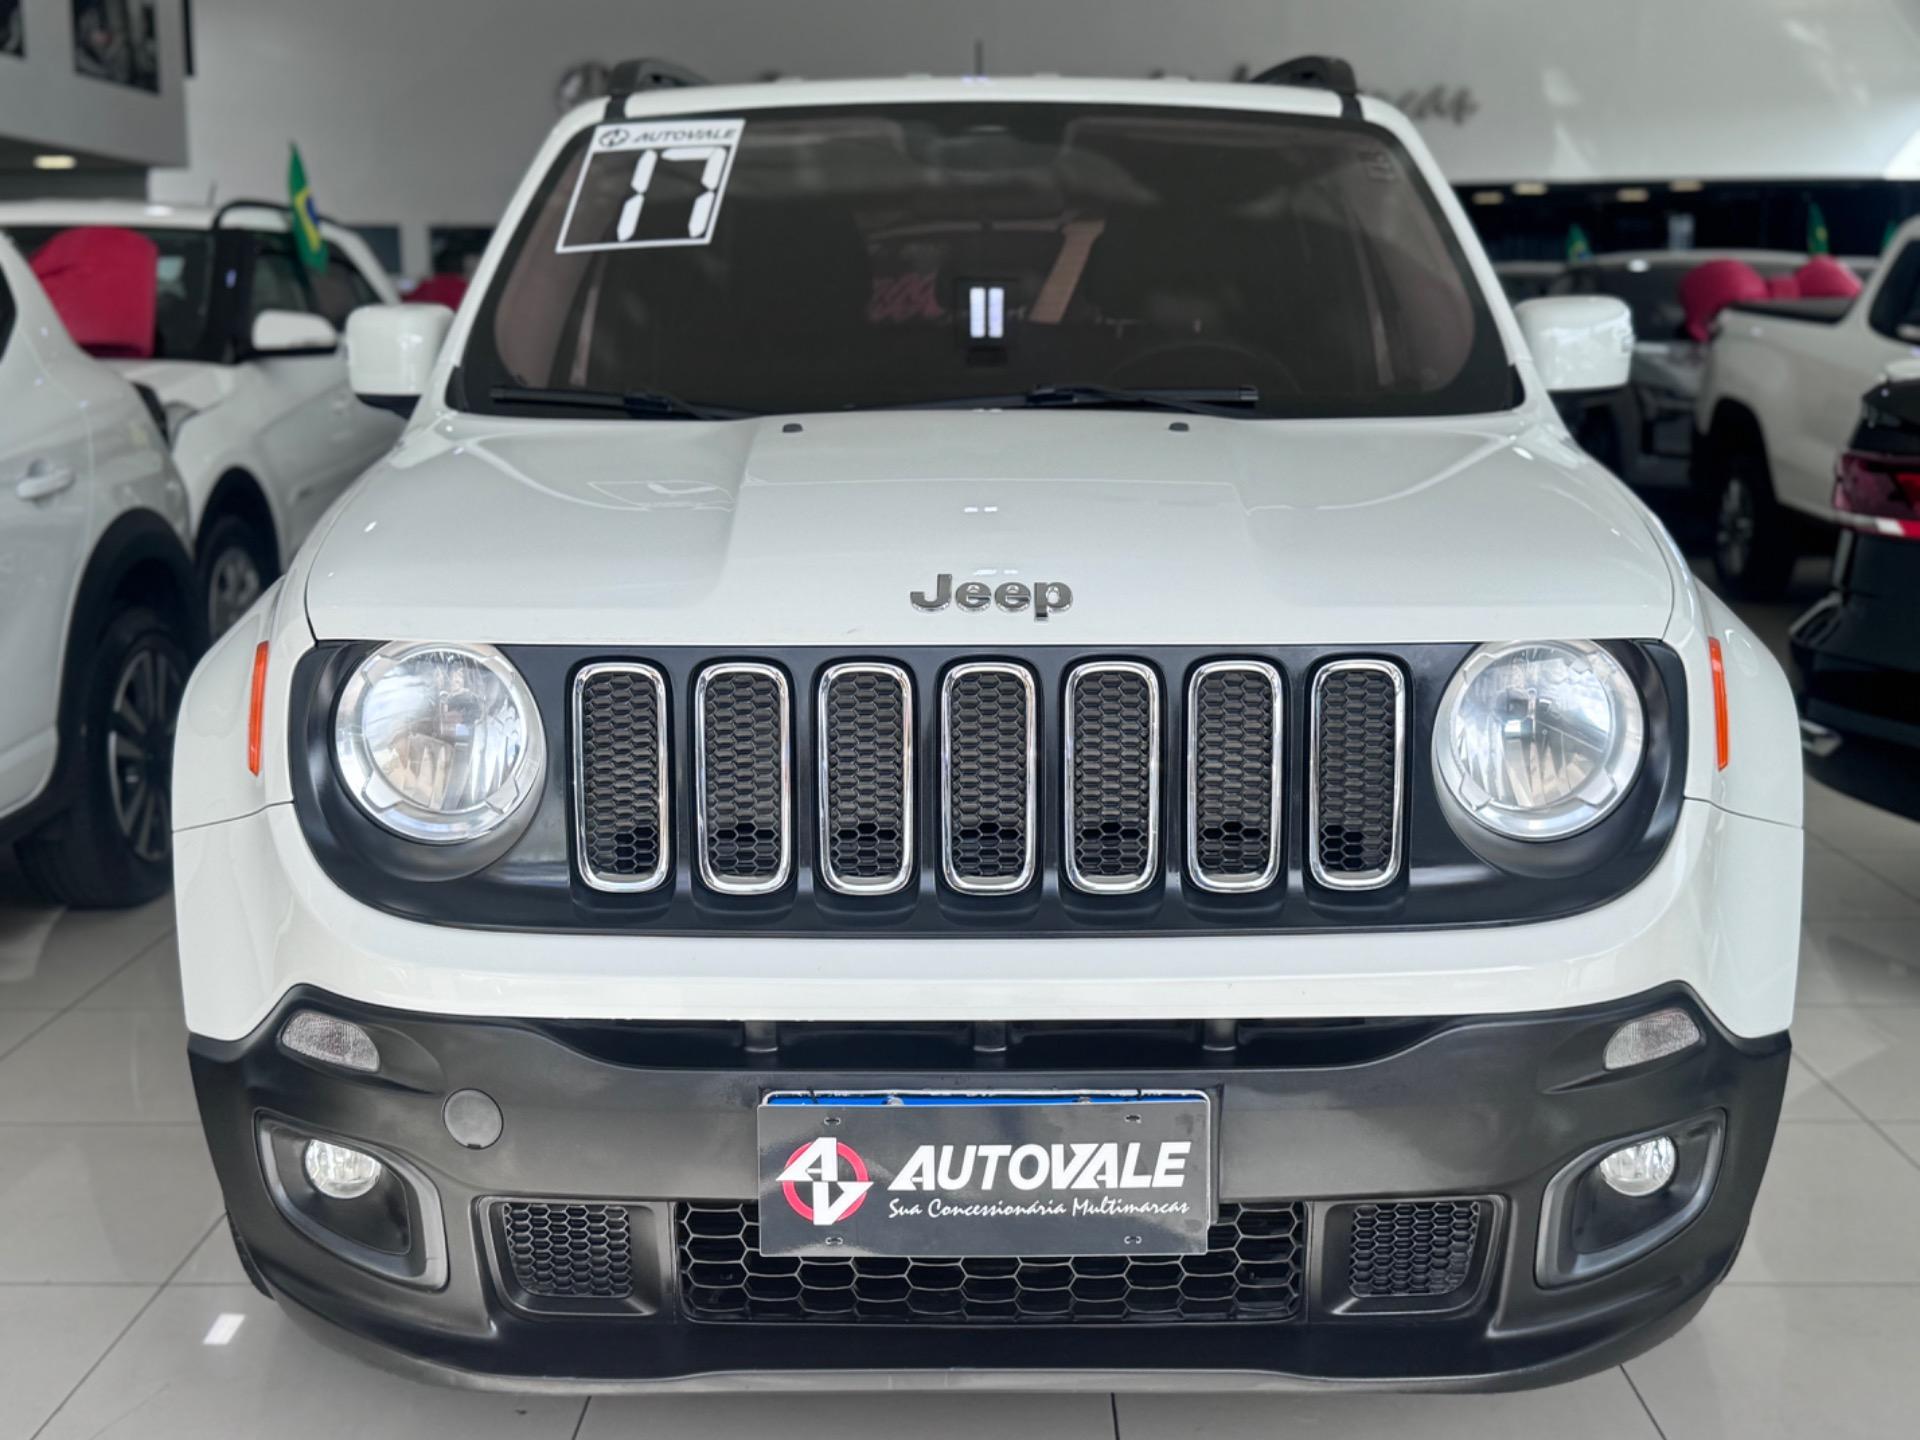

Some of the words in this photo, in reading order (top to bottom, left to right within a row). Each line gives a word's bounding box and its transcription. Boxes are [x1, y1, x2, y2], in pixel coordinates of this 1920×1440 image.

[634, 128, 737, 143] AUTOVALE
[617, 147, 728, 242] 17
[910, 574, 1073, 621] Jeep
[887, 1141, 1191, 1191] AUTOVALE
[888, 1198, 923, 1218] Sua
[928, 1198, 1067, 1218] Concessionária
[1072, 1196, 1190, 1217] Multimarcas
